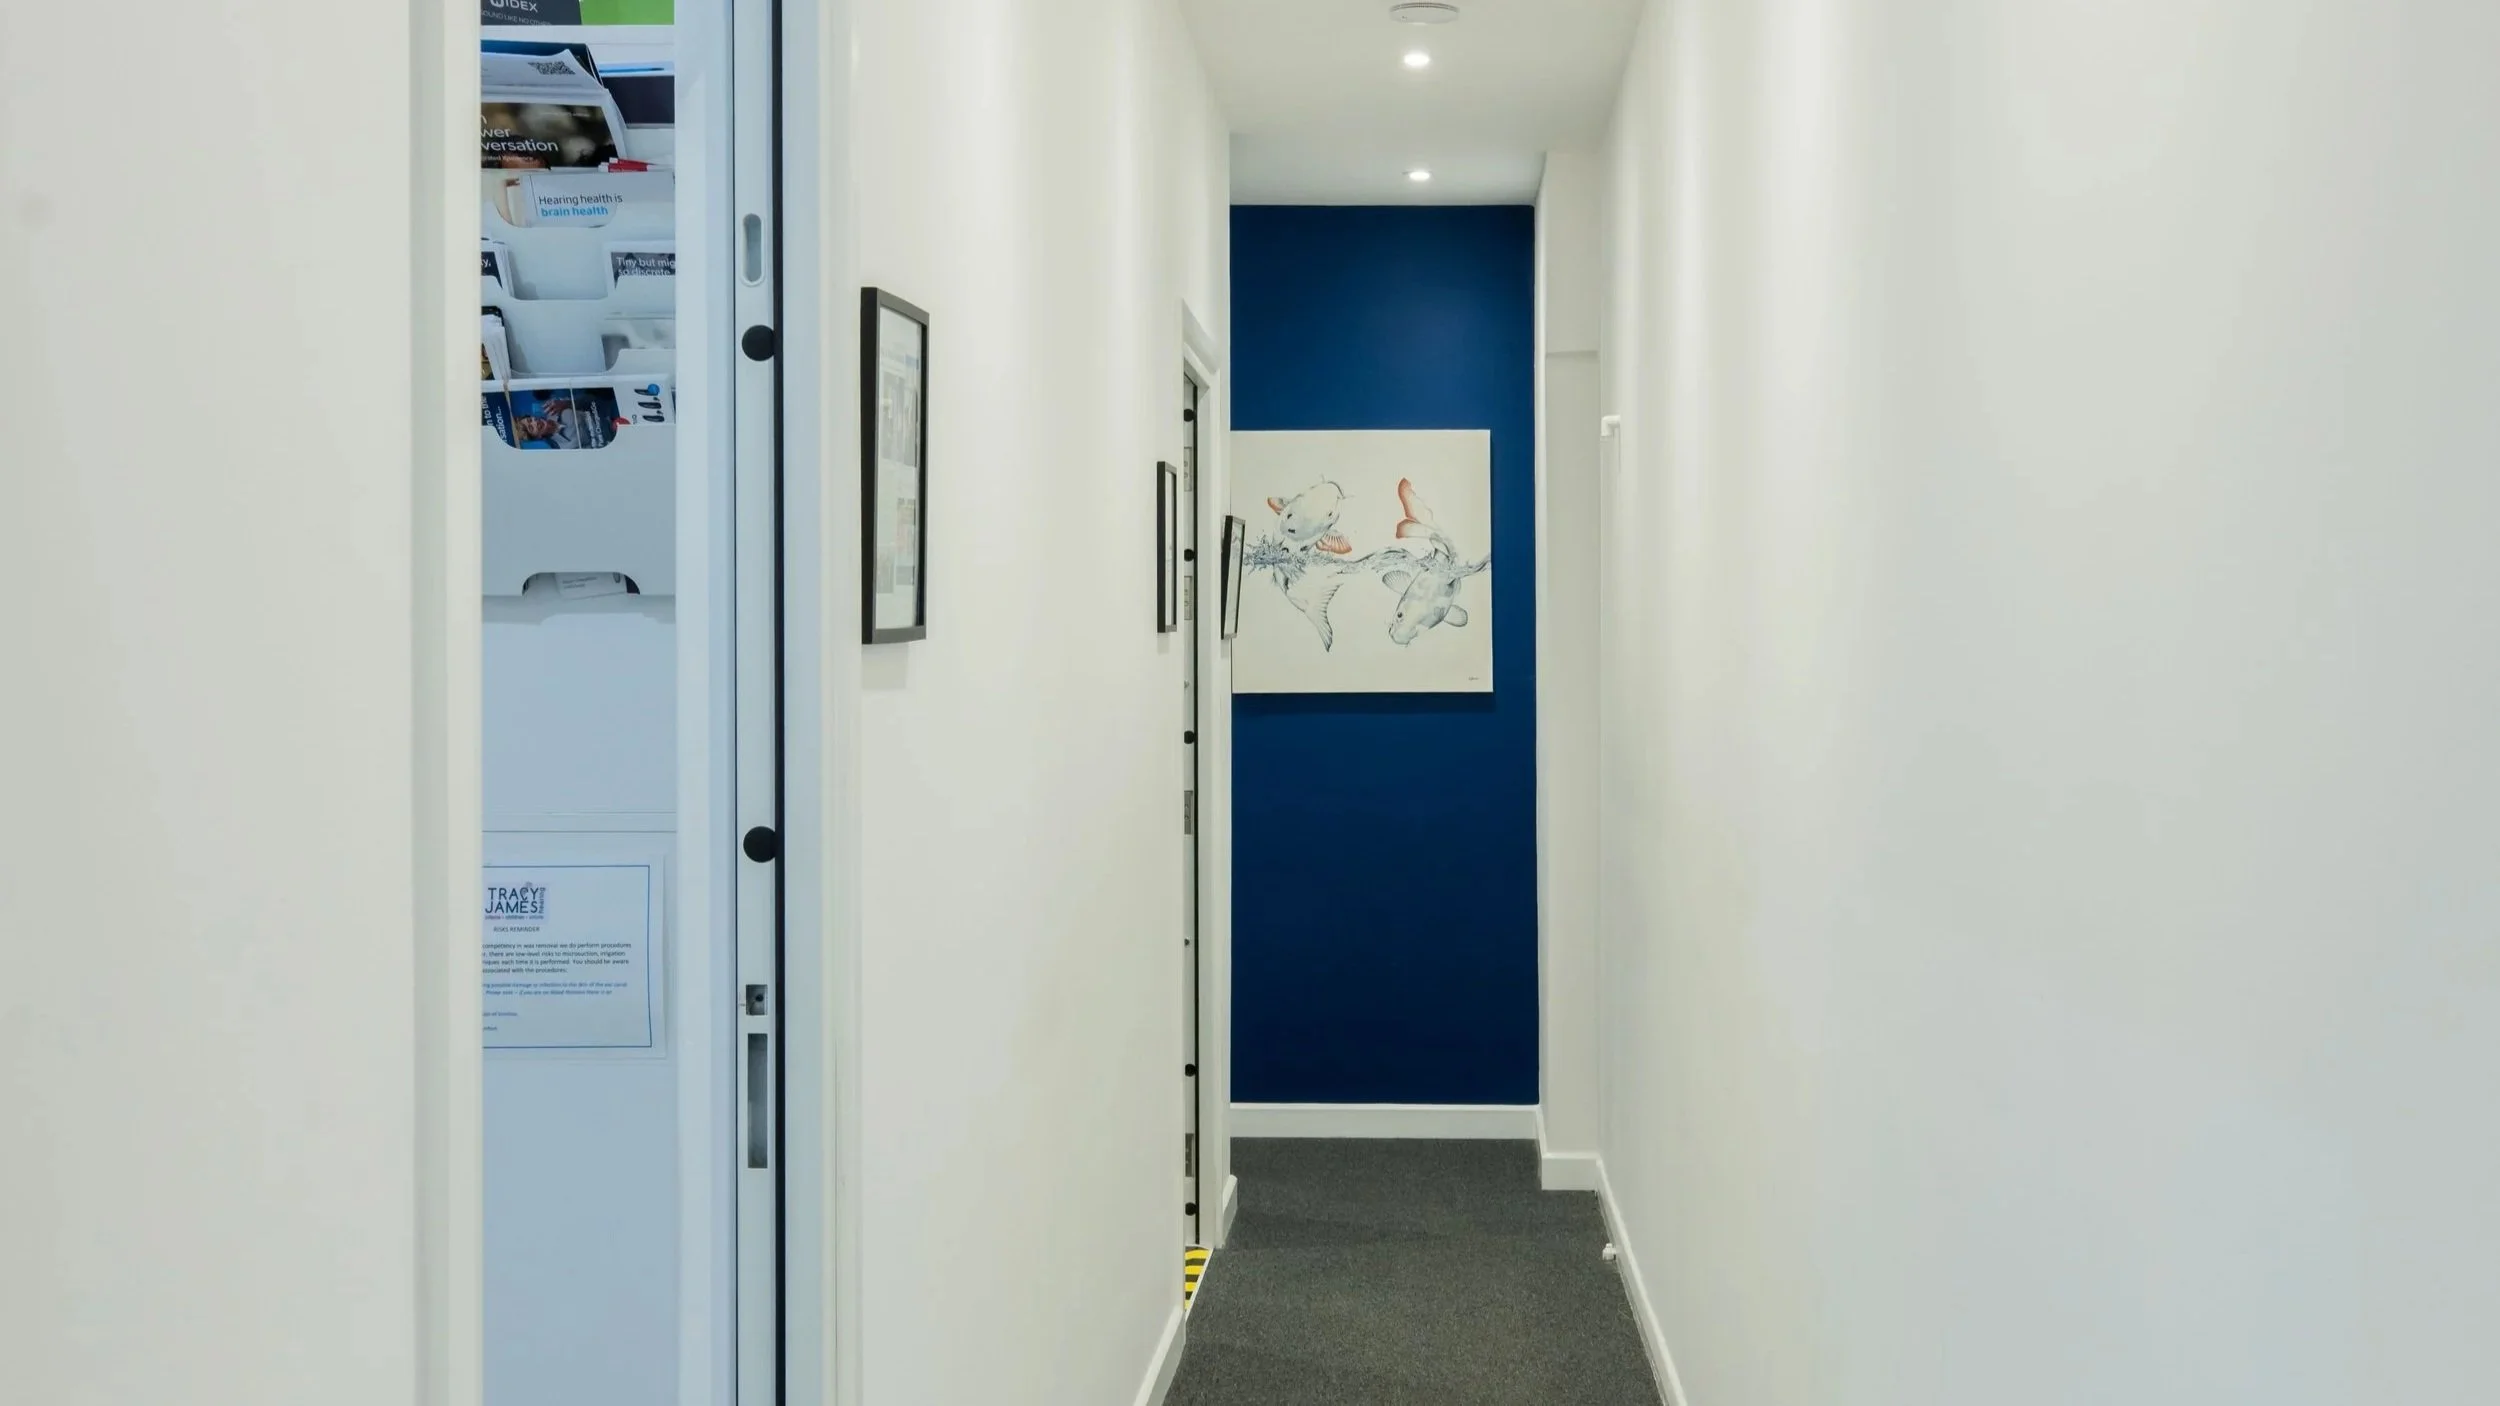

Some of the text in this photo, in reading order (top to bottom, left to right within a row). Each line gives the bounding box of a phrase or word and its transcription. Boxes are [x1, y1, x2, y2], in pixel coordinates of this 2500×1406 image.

[490, 0, 538, 13] WIDEX
[538, 193, 623, 206] Hearing health is
[541, 205, 609, 217] brain health
[616, 257, 637, 269] Tiny
[638, 257, 656, 267] but
[487, 887, 539, 901] TRACY
[485, 901, 538, 914] JAMES
